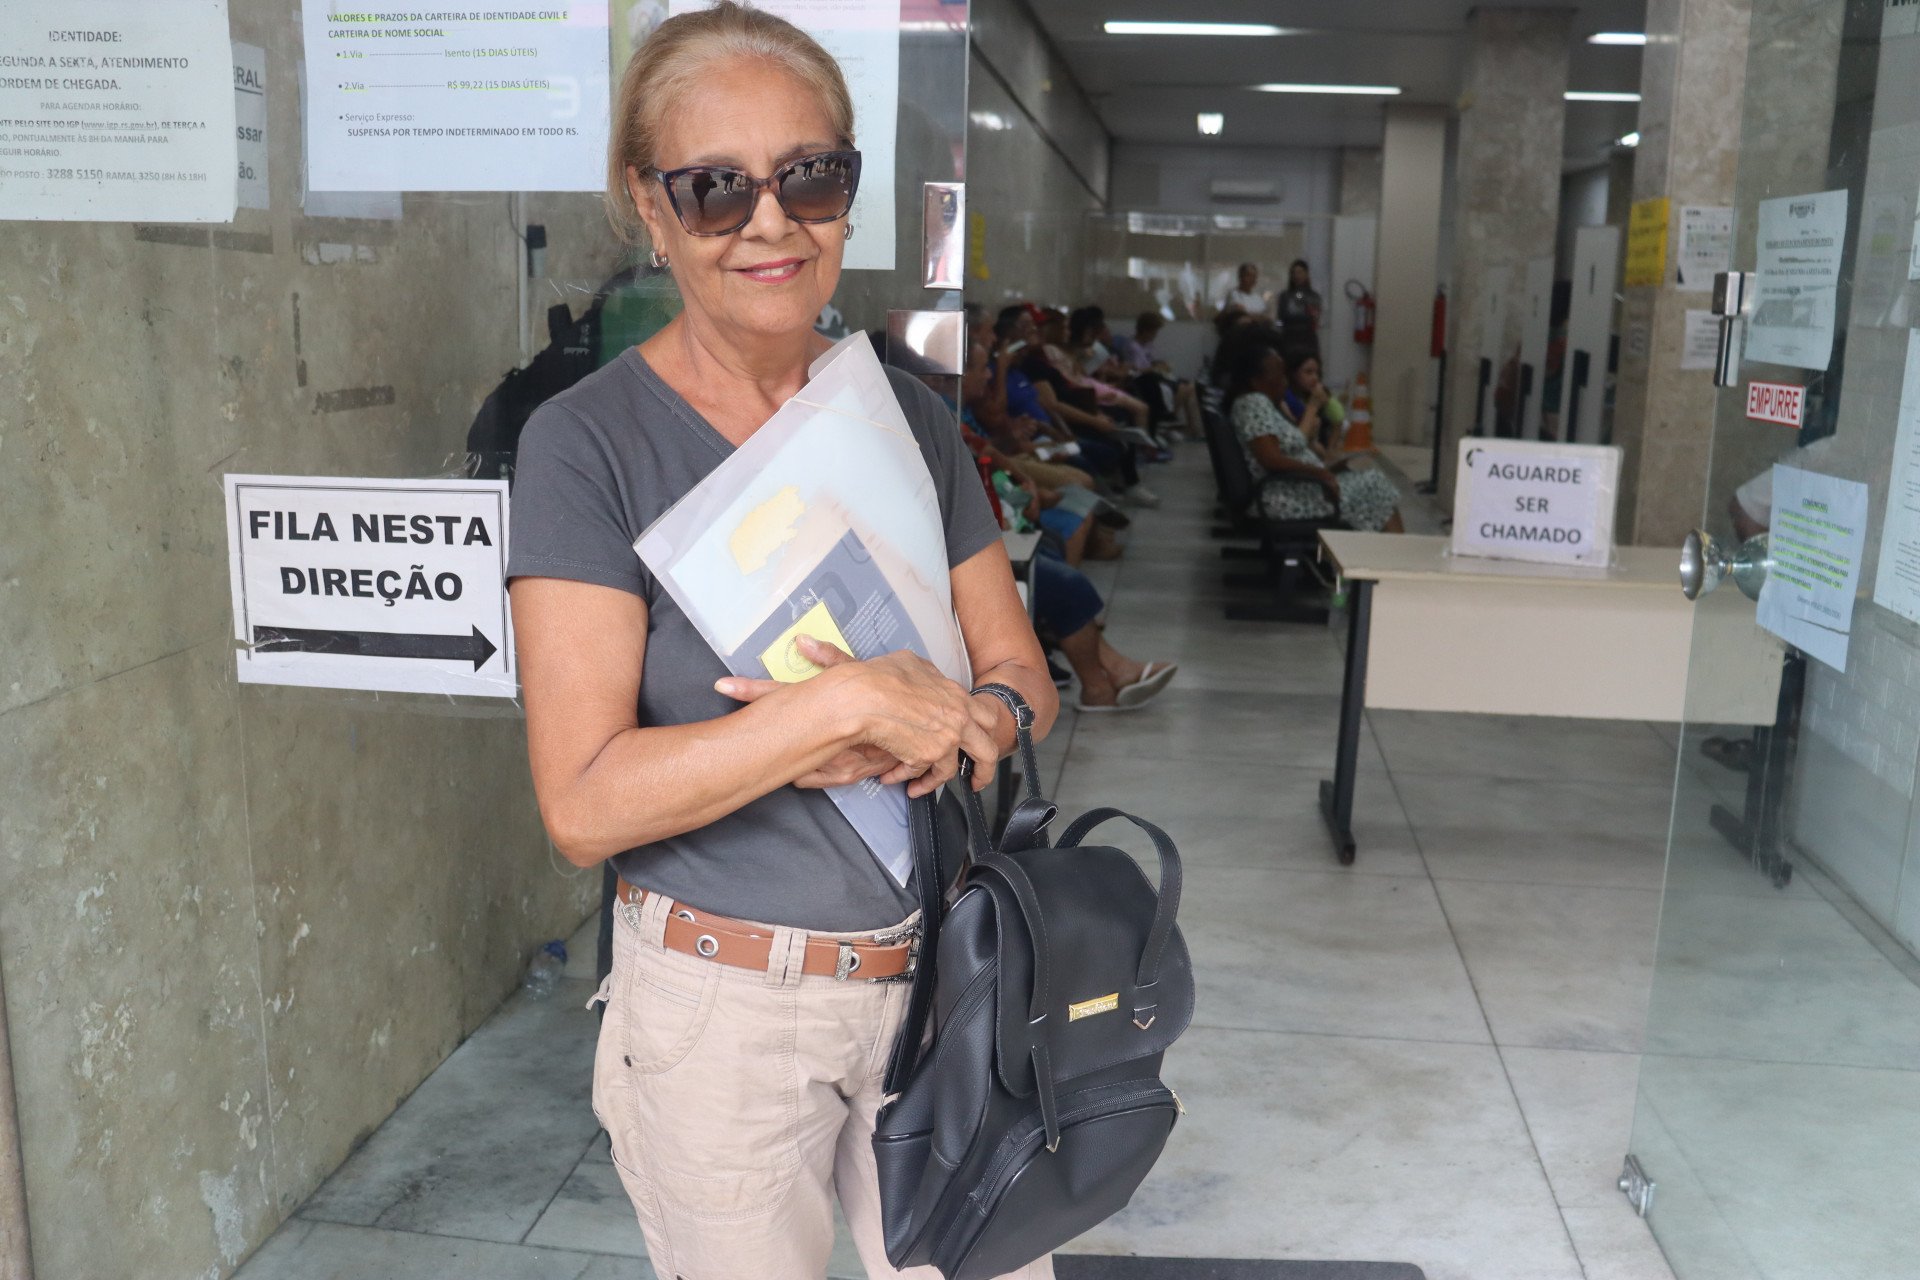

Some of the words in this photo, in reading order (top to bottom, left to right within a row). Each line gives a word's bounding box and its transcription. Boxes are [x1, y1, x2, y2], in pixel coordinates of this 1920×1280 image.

[326, 13, 366, 23] VALORES
[367, 13, 373, 22] E
[375, 12, 408, 22] PRAZOS
[410, 12, 423, 21] DA
[424, 12, 467, 21] CARTEIRA
[469, 11, 481, 21] DE
[483, 11, 536, 20] IDENTIDADE
[538, 10, 561, 20] CIVIL
[563, 11, 568, 19] E
[48, 30, 122, 42] IDENTIDADE:
[328, 29, 369, 38] CARTEIRA
[371, 29, 382, 38] DE
[385, 28, 411, 38] NOME
[413, 28, 445, 37] SOCIAL
[444, 48, 471, 58] Isento
[488, 47, 509, 57] DIAS
[510, 46, 538, 58] ÚTEIS)
[48, 56, 57, 68] A
[60, 56, 99, 71] SEXTA,
[101, 57, 189, 69] ATENDIMENTO
[0, 77, 42, 90] ORDEM
[44, 78, 60, 90] DE
[63, 78, 122, 91] CHEGADA.
[447, 80, 458, 91] R$
[460, 80, 483, 91] 99,22
[501, 80, 521, 89] DIAS
[523, 78, 550, 90] ÚTEIS)
[40, 101, 61, 111] PARA
[62, 101, 101, 111] AGENDAR
[103, 101, 142, 112] HORÁRIO:
[345, 112, 375, 123] Serviço
[376, 112, 415, 124] Expresso:
[15, 119, 35, 129] PELO
[36, 120, 52, 129] SITE
[53, 120, 64, 129] DO
[66, 120, 80, 129] IGP
[161, 121, 170, 130] DE
[172, 121, 198, 131] TERÇA
[347, 128, 391, 137] SUSPENSA
[393, 128, 411, 137] POR
[412, 128, 444, 137] TEMPO
[446, 127, 520, 137] INDETERMINADO
[521, 128, 536, 136] EM
[538, 127, 564, 136] TODO
[565, 127, 579, 137] RS.
[12, 134, 76, 143] PONTUALMENTE
[100, 135, 113, 144] DA
[114, 134, 146, 144] MANHÃ
[147, 135, 169, 144] PARA
[14, 170, 40, 179] POSTO
[46, 168, 74, 180] 3288
[76, 168, 103, 181] 5150
[106, 171, 138, 182] RAMAL
[139, 171, 160, 182] 3250
[1750, 386, 1799, 420] EMPURRE
[1487, 463, 1583, 485] AGUARDE
[1514, 496, 1549, 514] SER
[249, 510, 339, 542] FILA
[352, 513, 492, 546] NESTA
[1480, 522, 1582, 545] CHAMADO
[280, 564, 463, 607] DIREÇÃO
